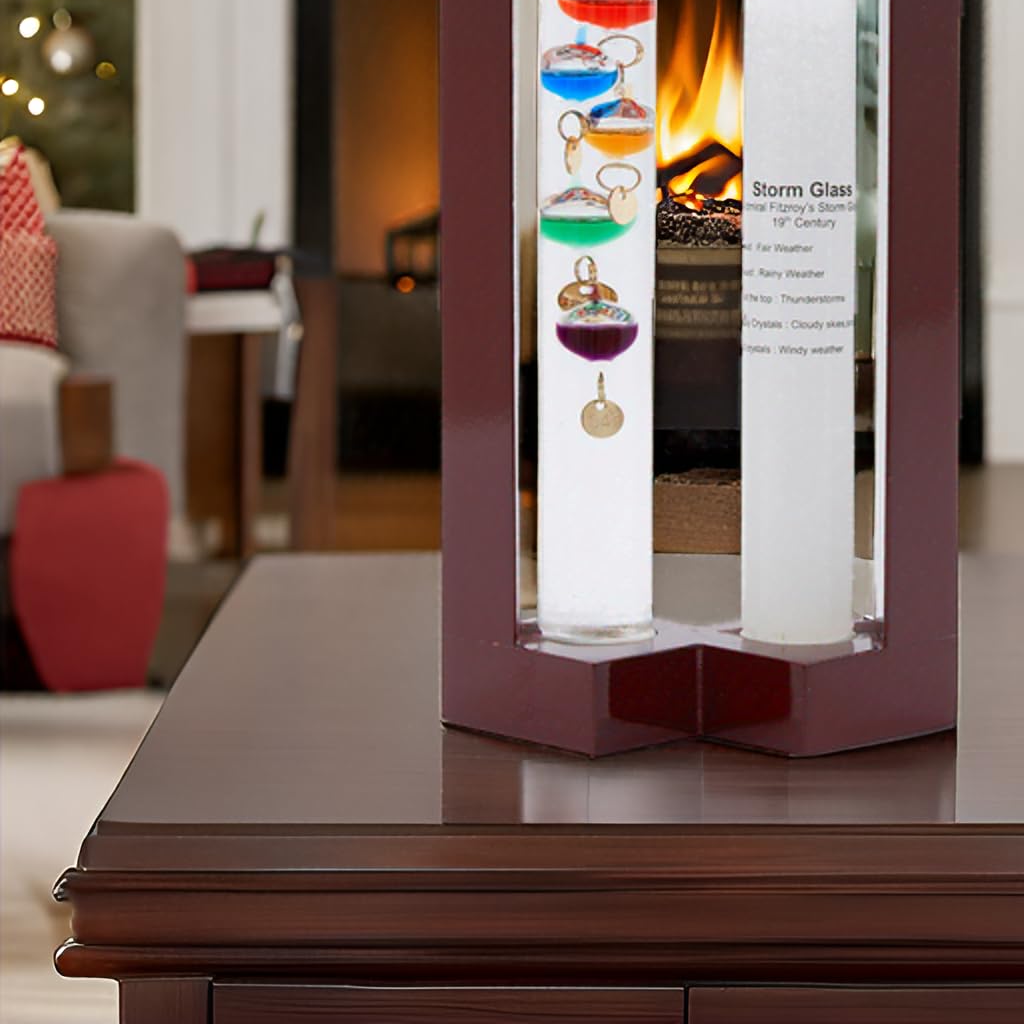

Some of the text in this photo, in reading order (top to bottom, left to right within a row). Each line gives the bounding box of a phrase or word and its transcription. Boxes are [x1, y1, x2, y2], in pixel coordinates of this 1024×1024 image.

[753, 181, 854, 198] Storm Glass
[769, 202, 815, 215] Fitzroy's
[818, 202, 845, 212] Storm
[794, 217, 836, 229] Century
[756, 243, 772, 252] Fair
[774, 243, 814, 253] Weather
[759, 268, 783, 280] Rainy
[785, 269, 825, 279] Weather
[781, 294, 846, 304] Thunderstorms
[791, 319, 824, 330] Cloudy
[778, 345, 809, 356] Windy
[811, 345, 844, 354] weather
